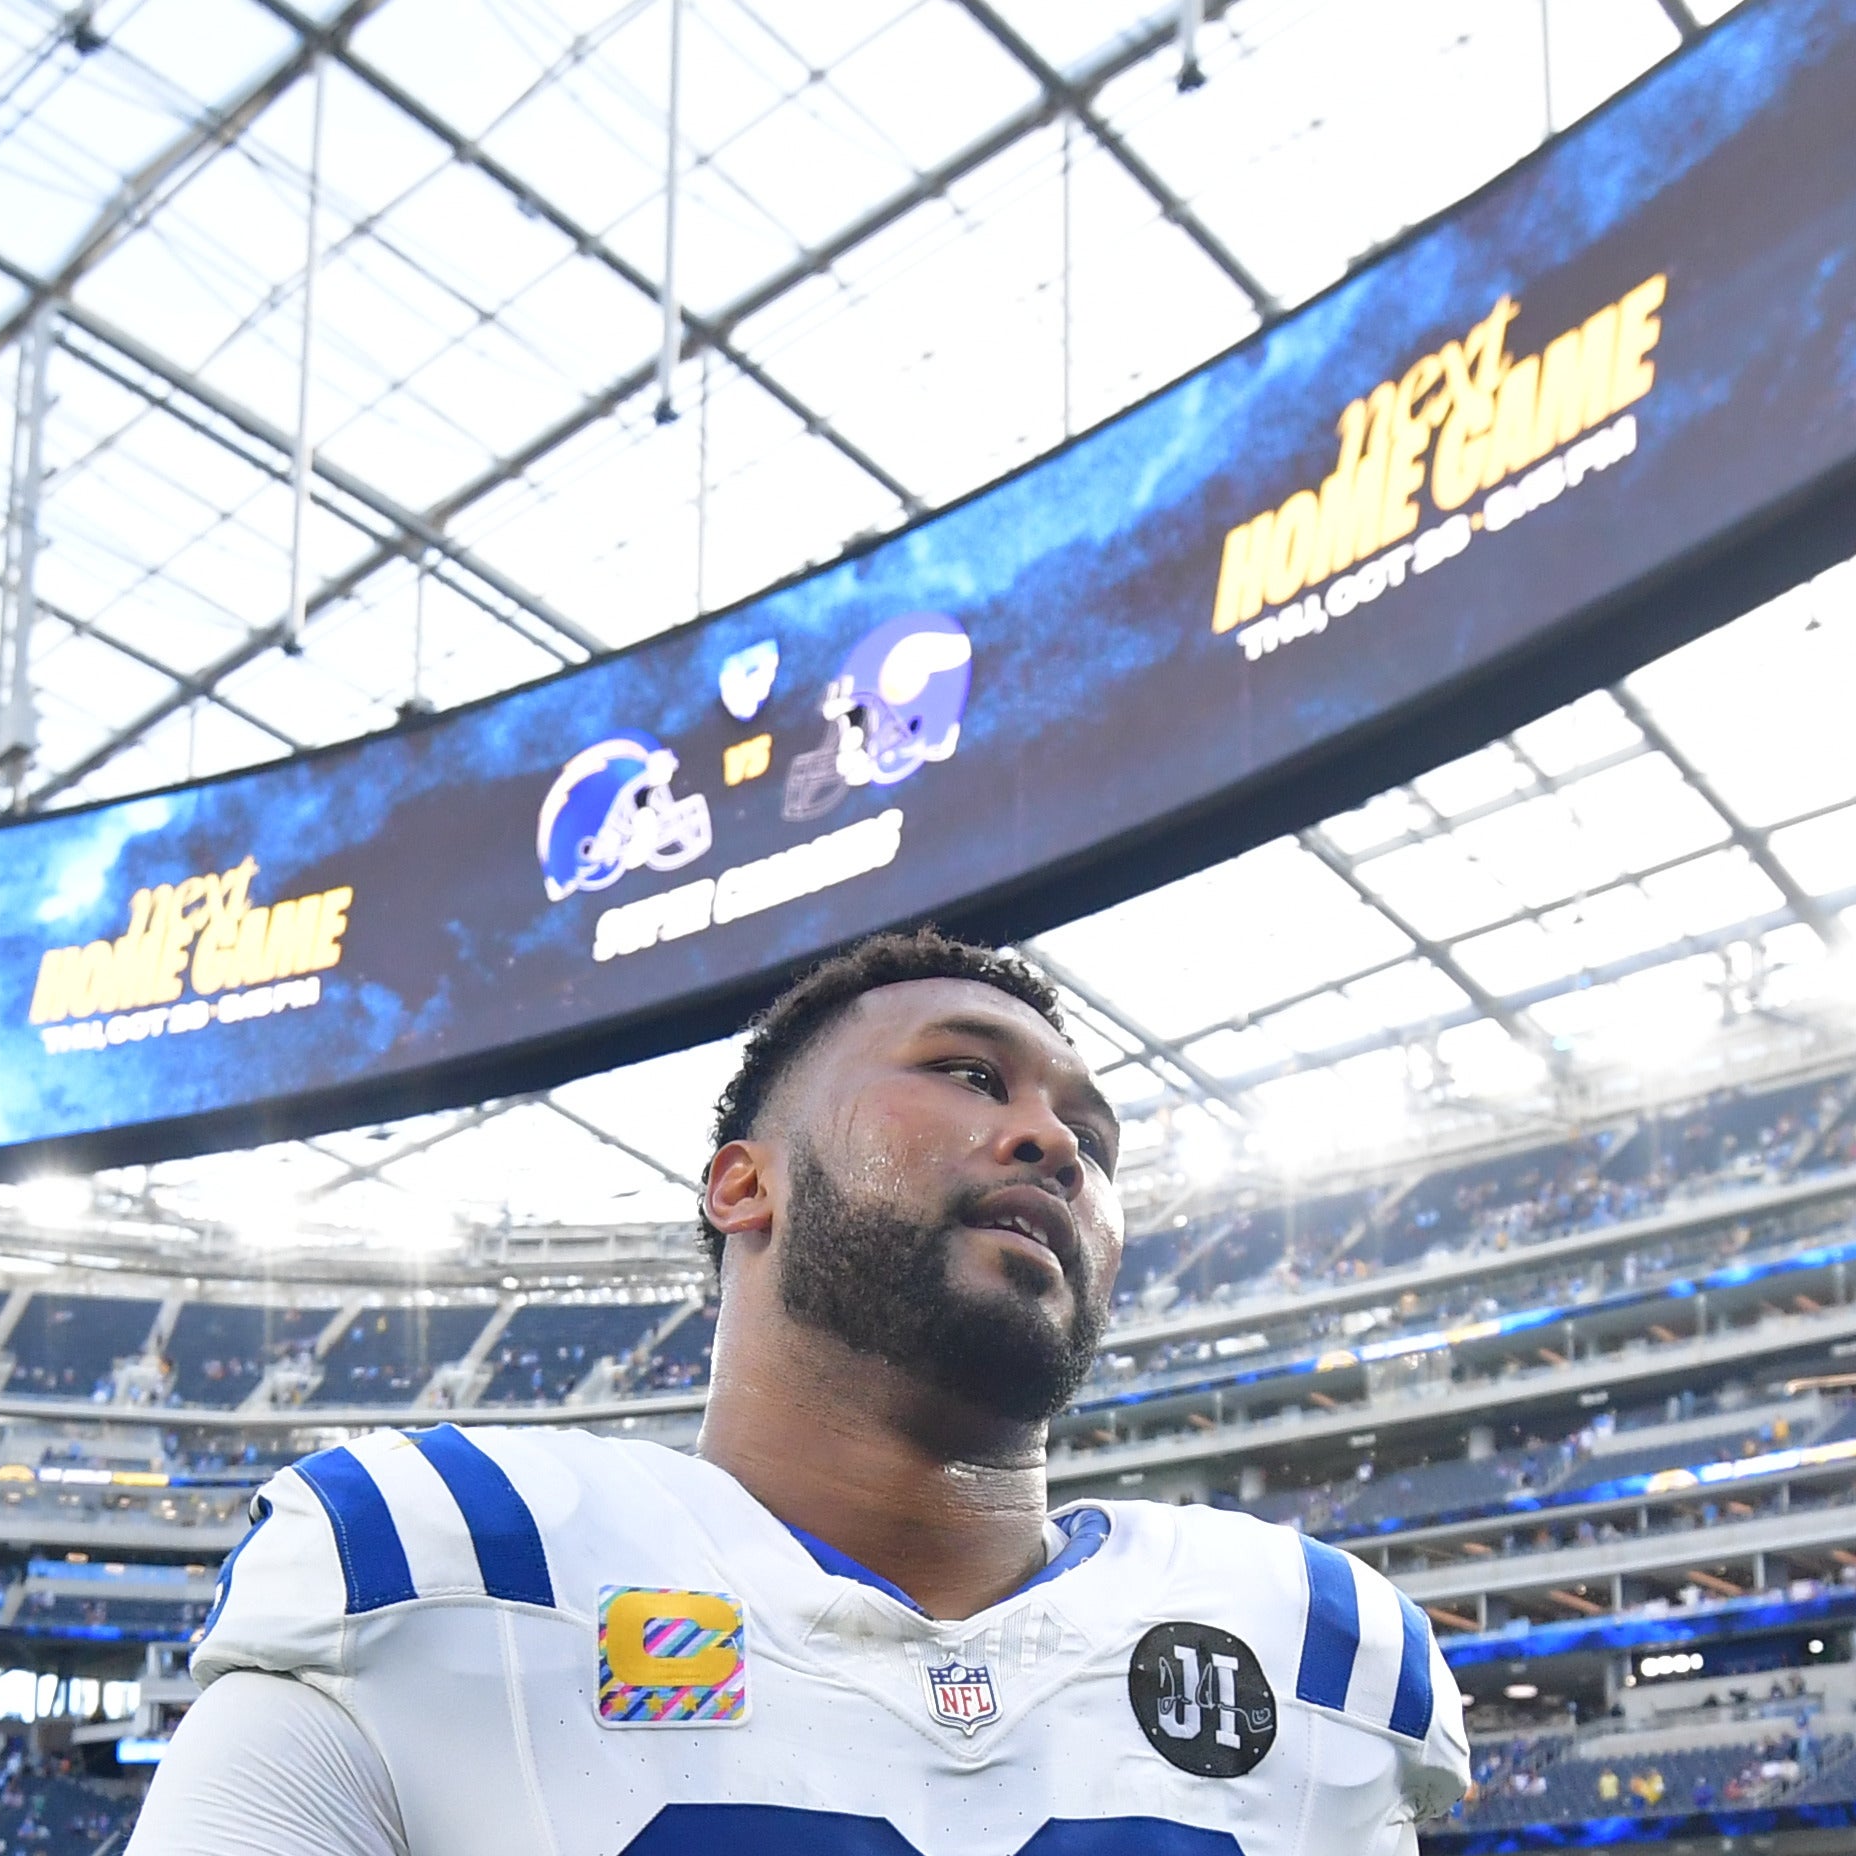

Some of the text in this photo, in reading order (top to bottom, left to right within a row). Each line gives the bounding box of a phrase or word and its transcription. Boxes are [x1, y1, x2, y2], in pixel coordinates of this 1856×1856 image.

[1212, 273, 1667, 635] HOME GAME
[28, 886, 353, 1025] HOME GAME
[605, 1590, 743, 1686] C
[941, 1684, 991, 1715] NFL
